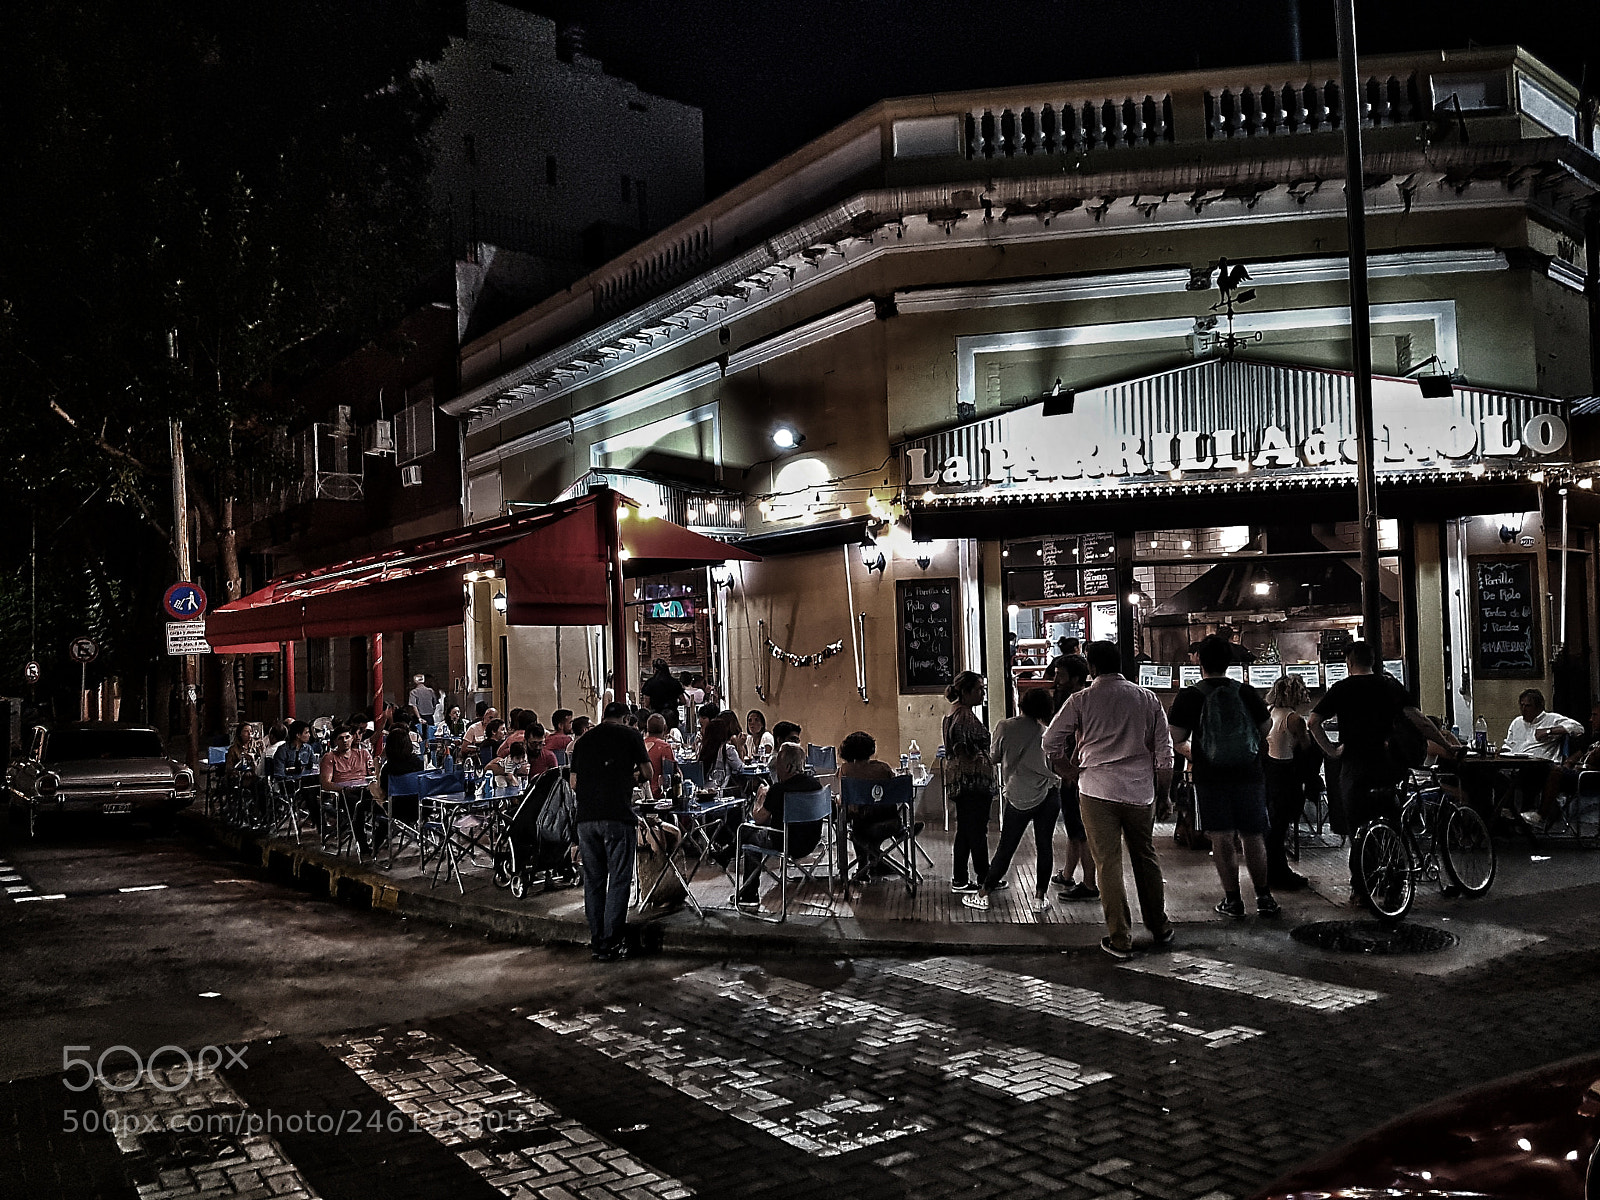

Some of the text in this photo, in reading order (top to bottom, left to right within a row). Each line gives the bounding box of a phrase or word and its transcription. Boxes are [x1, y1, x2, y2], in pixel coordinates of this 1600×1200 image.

[907, 448, 970, 486] La
[1484, 570, 1514, 585] Parrilla
[941, 586, 950, 594] de
